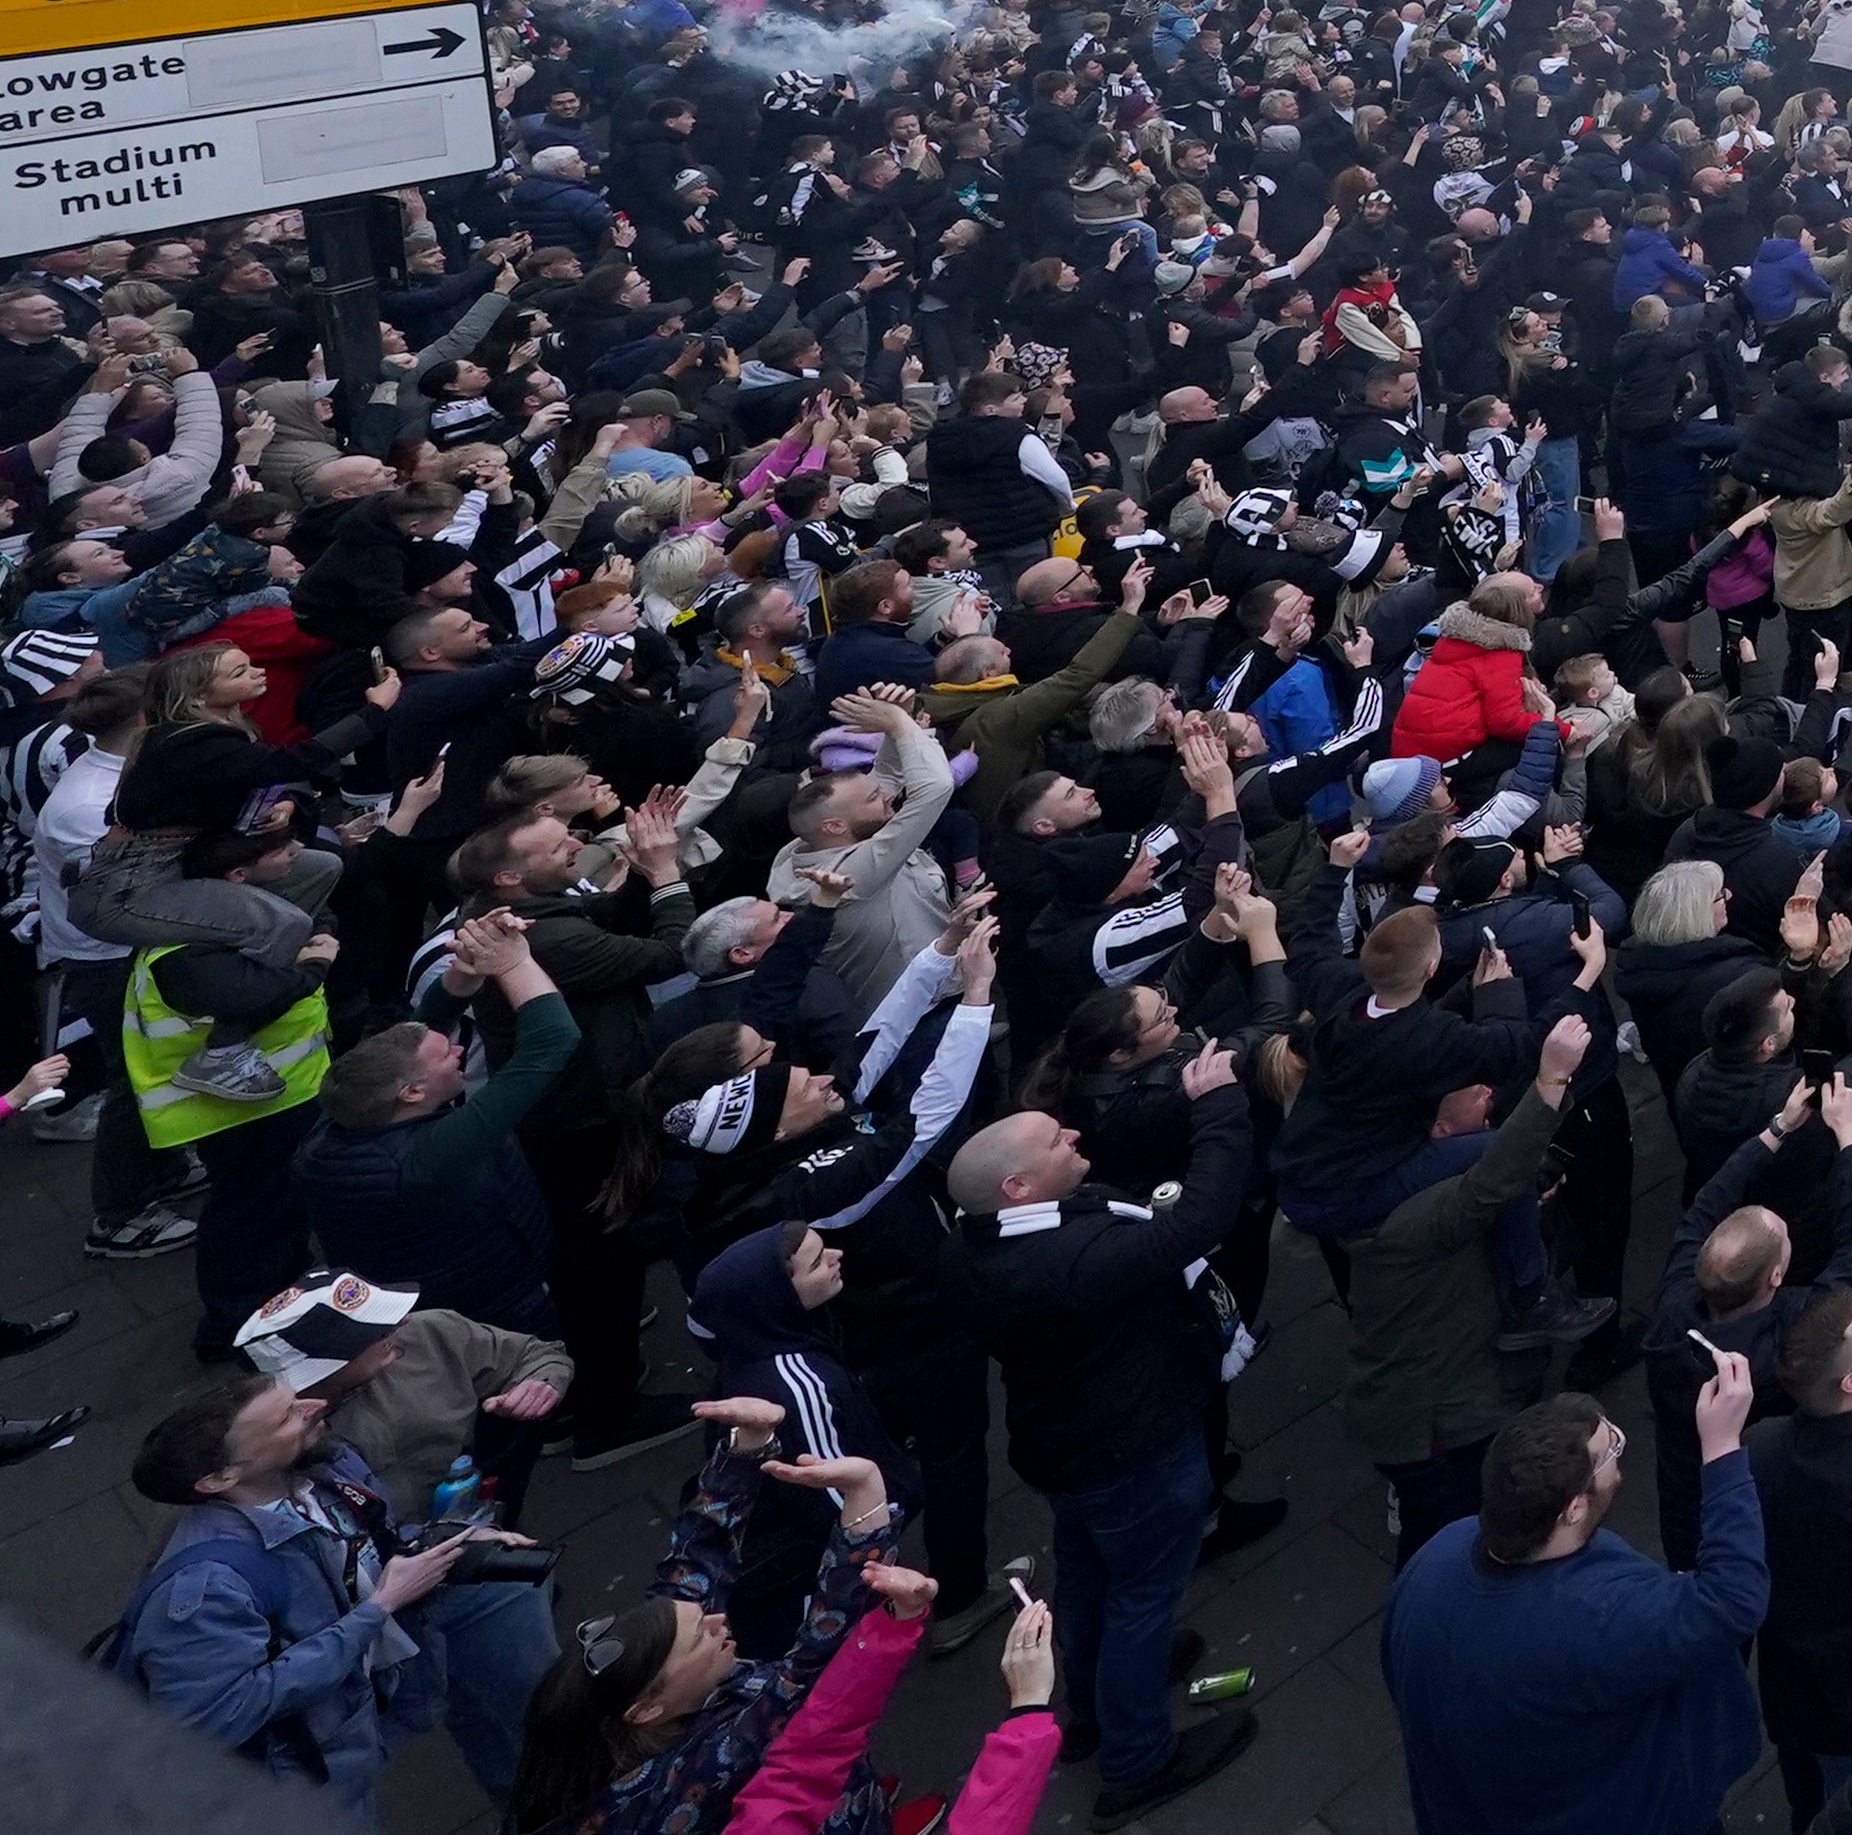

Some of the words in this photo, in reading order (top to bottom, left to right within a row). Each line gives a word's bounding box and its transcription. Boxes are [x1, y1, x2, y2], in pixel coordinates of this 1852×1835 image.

[0, 101, 105, 132] area
[15, 137, 217, 189] Stadium
[60, 173, 183, 215] multi
